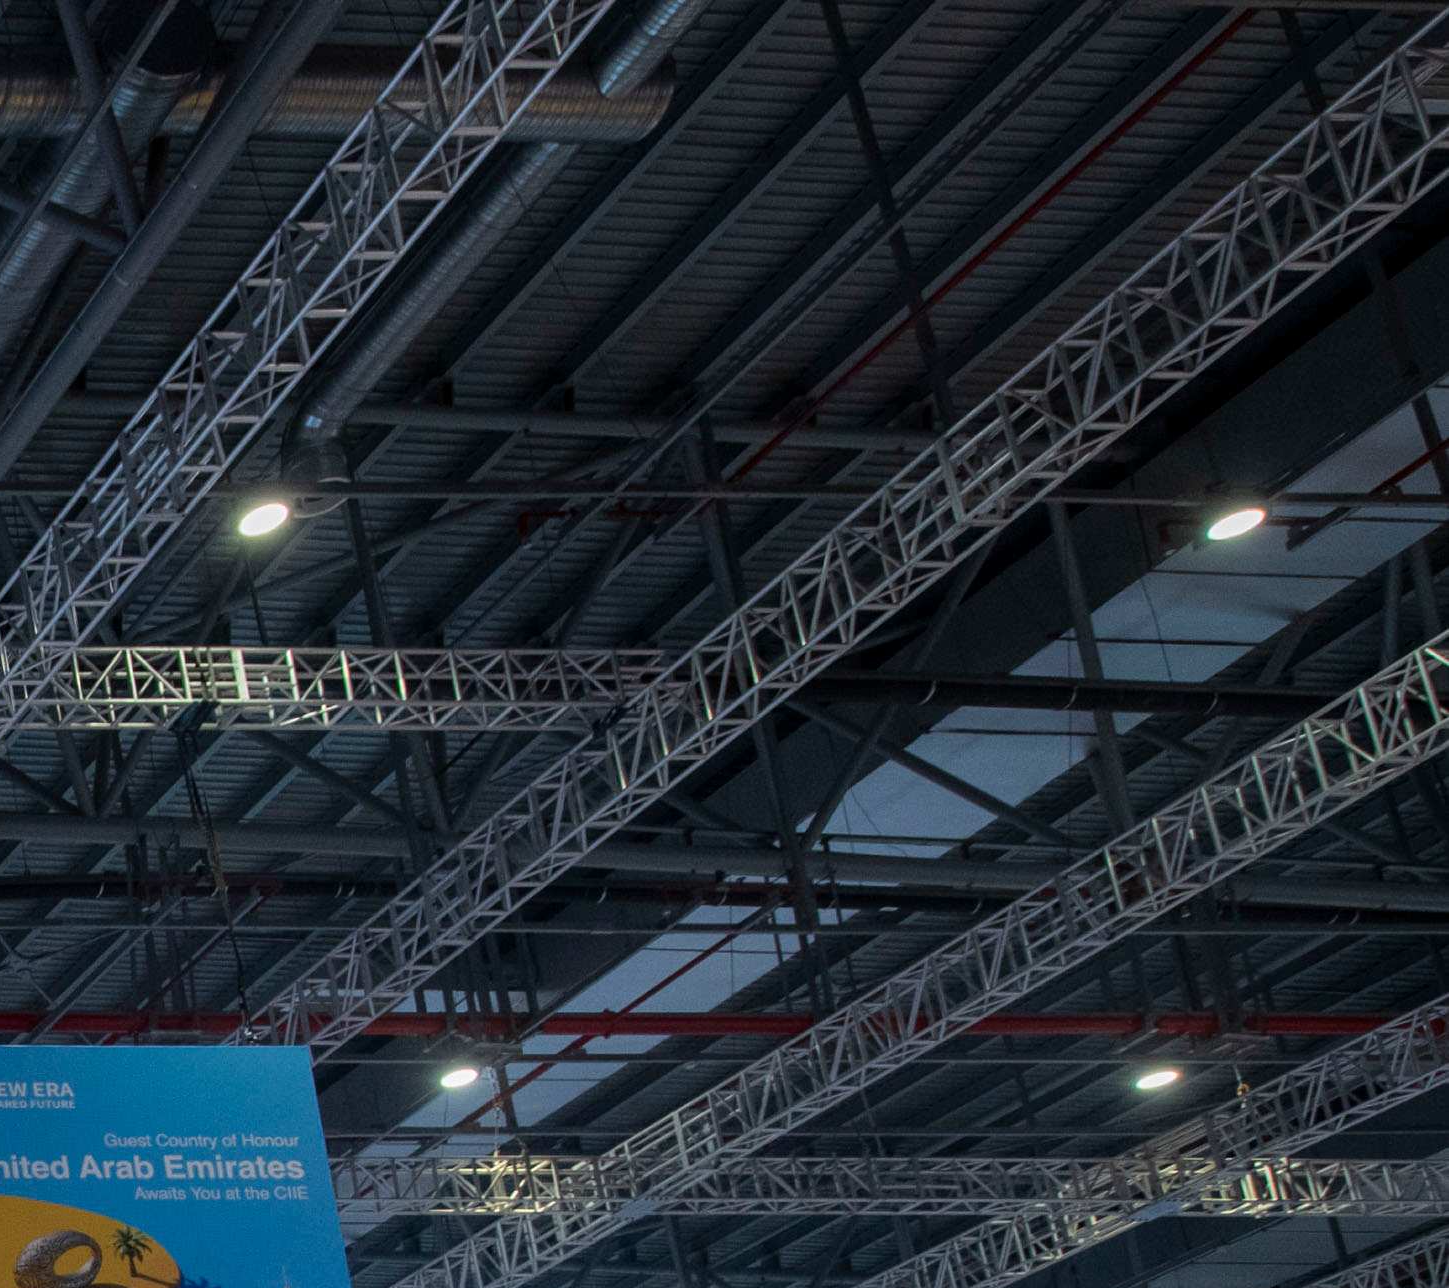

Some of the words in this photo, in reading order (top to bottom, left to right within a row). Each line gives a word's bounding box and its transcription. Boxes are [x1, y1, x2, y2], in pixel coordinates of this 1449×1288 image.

[32, 1082, 75, 1098] ERA
[30, 1099, 76, 1110] FUTURE
[104, 1133, 152, 1148] Guest
[155, 1133, 218, 1151] Country
[221, 1133, 239, 1148] of
[241, 1134, 300, 1148] Honour
[79, 1154, 155, 1180] Arab
[163, 1154, 306, 1180] Emirates
[134, 1185, 187, 1201] Awaits
[190, 1186, 222, 1201] You
[225, 1187, 241, 1201] at
[244, 1186, 270, 1201] the
[273, 1185, 310, 1200] CIIE
